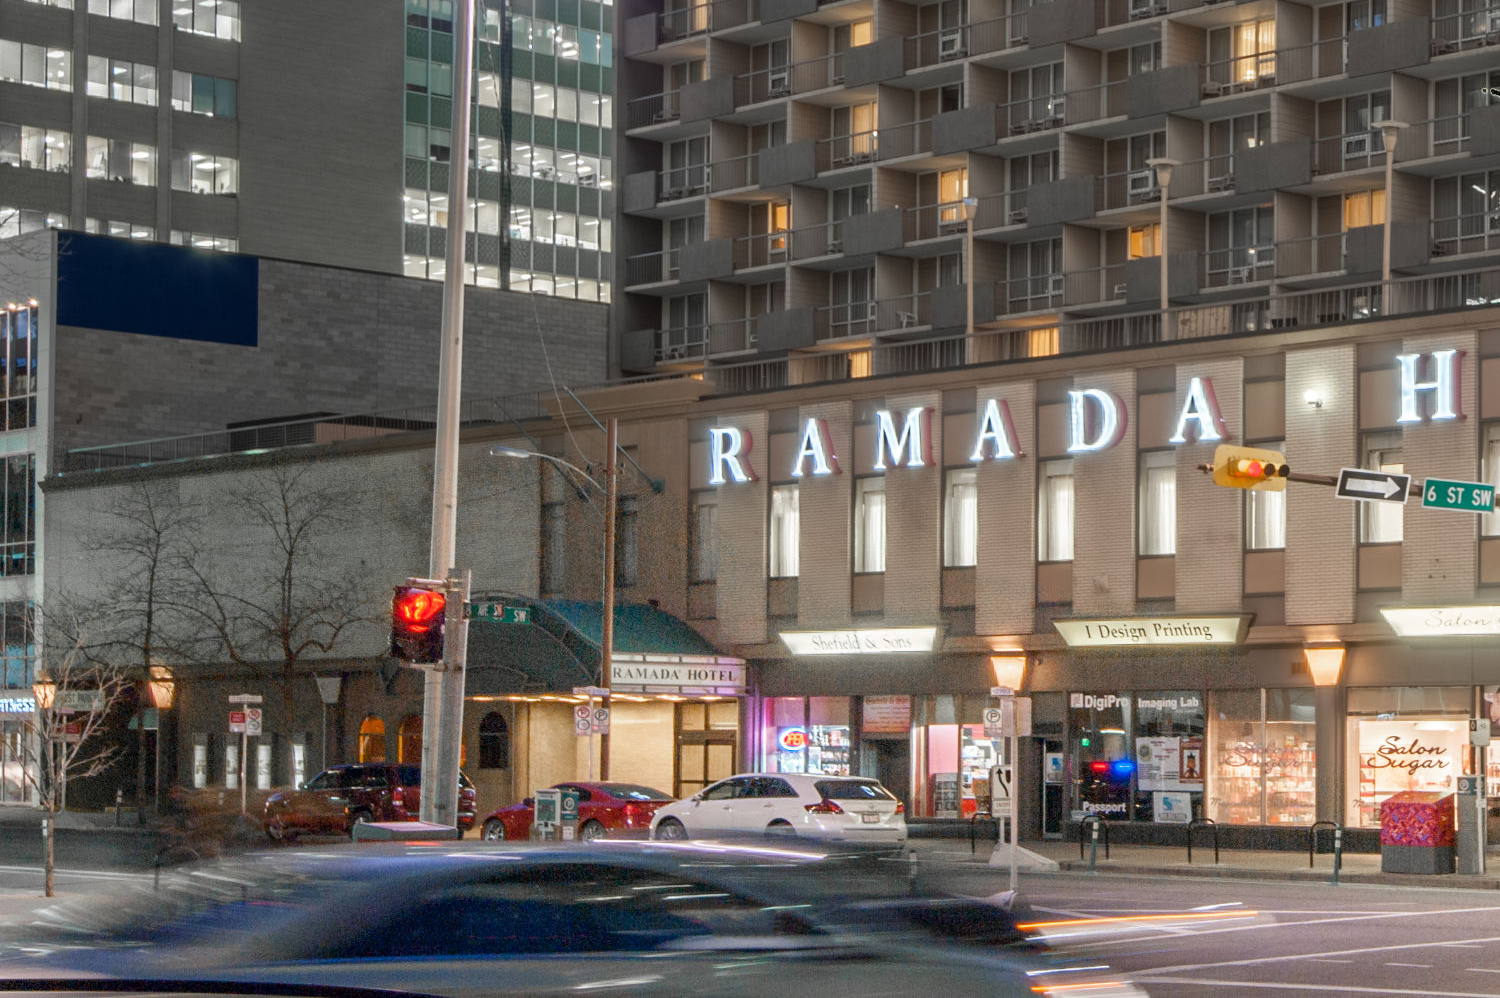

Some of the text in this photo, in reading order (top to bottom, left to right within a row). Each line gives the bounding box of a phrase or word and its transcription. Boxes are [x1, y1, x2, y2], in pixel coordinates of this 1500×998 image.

[709, 377, 1229, 485] RAMADA
[1427, 485, 1492, 506] 6 ST SW
[1424, 609, 1490, 627] Salon
[1098, 624, 1147, 642] Design
[1153, 622, 1213, 641] Printing
[811, 634, 913, 650] Shefield & Sons
[613, 666, 737, 682] RAMADA HOTEL
[1084, 694, 1199, 711] DigiPro Imaging Lab
[1378, 735, 1448, 756] Salon
[1367, 745, 1451, 776] Sugar
[1083, 801, 1127, 814] Passport
